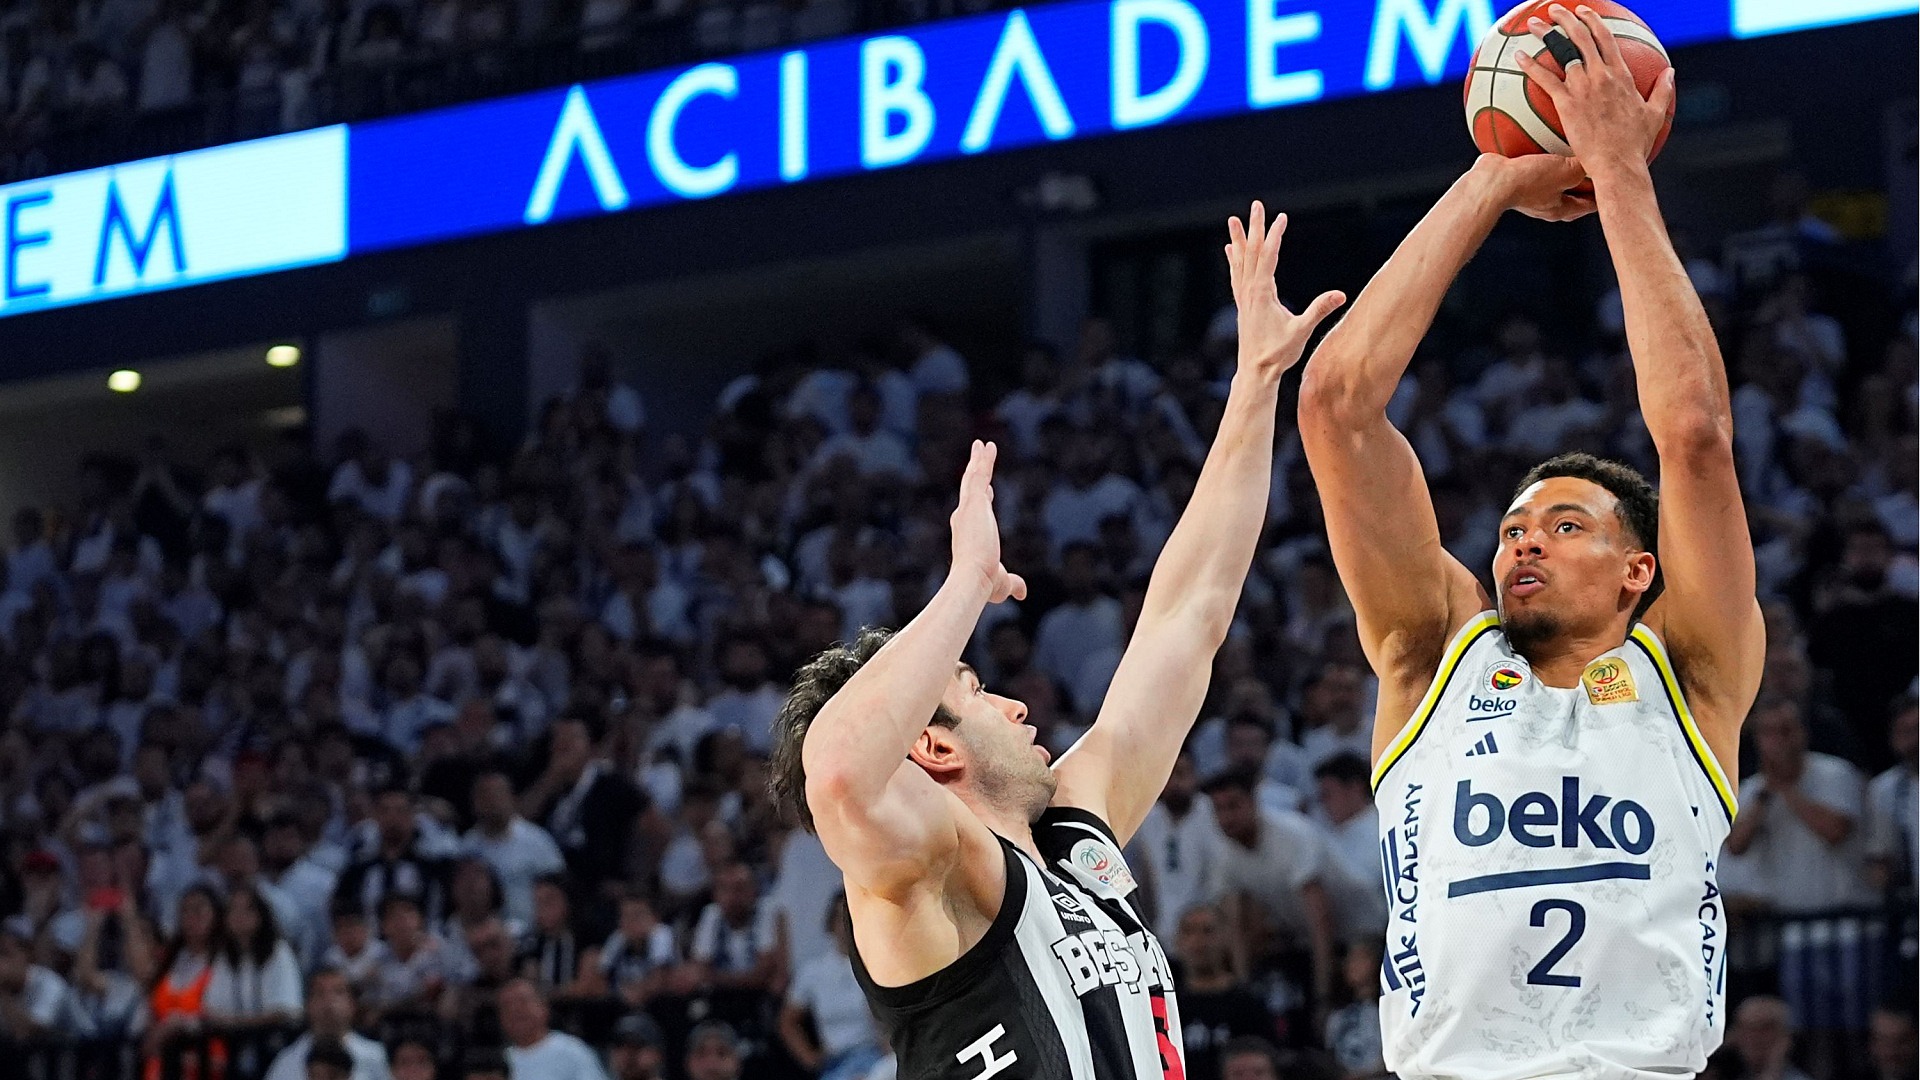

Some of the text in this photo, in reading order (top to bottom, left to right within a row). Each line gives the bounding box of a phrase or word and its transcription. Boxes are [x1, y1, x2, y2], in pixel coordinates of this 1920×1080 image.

[523, 0, 1497, 225] ACIBADEM
[1469, 694, 1517, 712] beko
[1453, 776, 1655, 856] beko
[1060, 911, 1092, 924] umbro
[1526, 898, 1586, 988] 2
